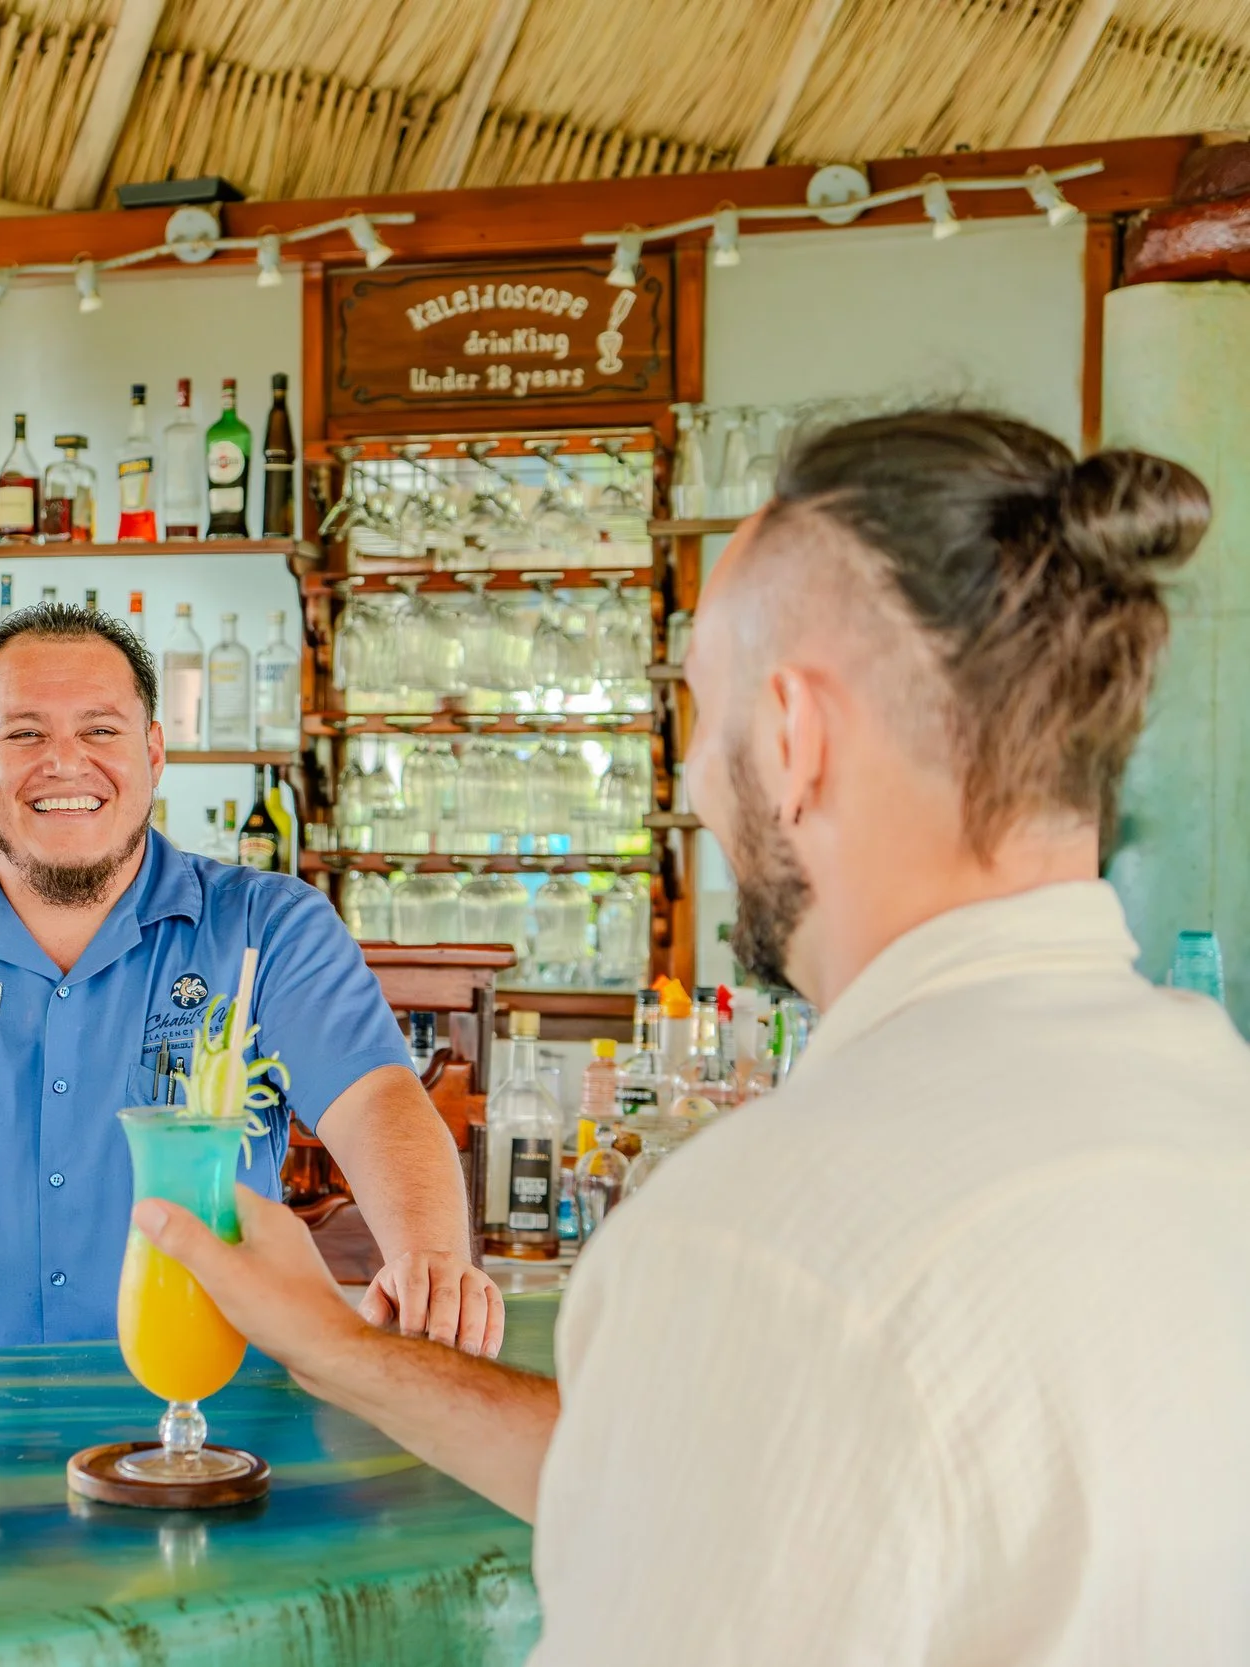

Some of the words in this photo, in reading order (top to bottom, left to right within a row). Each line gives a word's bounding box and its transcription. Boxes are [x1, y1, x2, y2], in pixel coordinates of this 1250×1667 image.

[409, 365, 480, 392] Under
[486, 363, 512, 390] 18
[513, 367, 585, 397] years
[145, 1008, 200, 1033] Chabil
[144, 1028, 194, 1042] LACENCI
